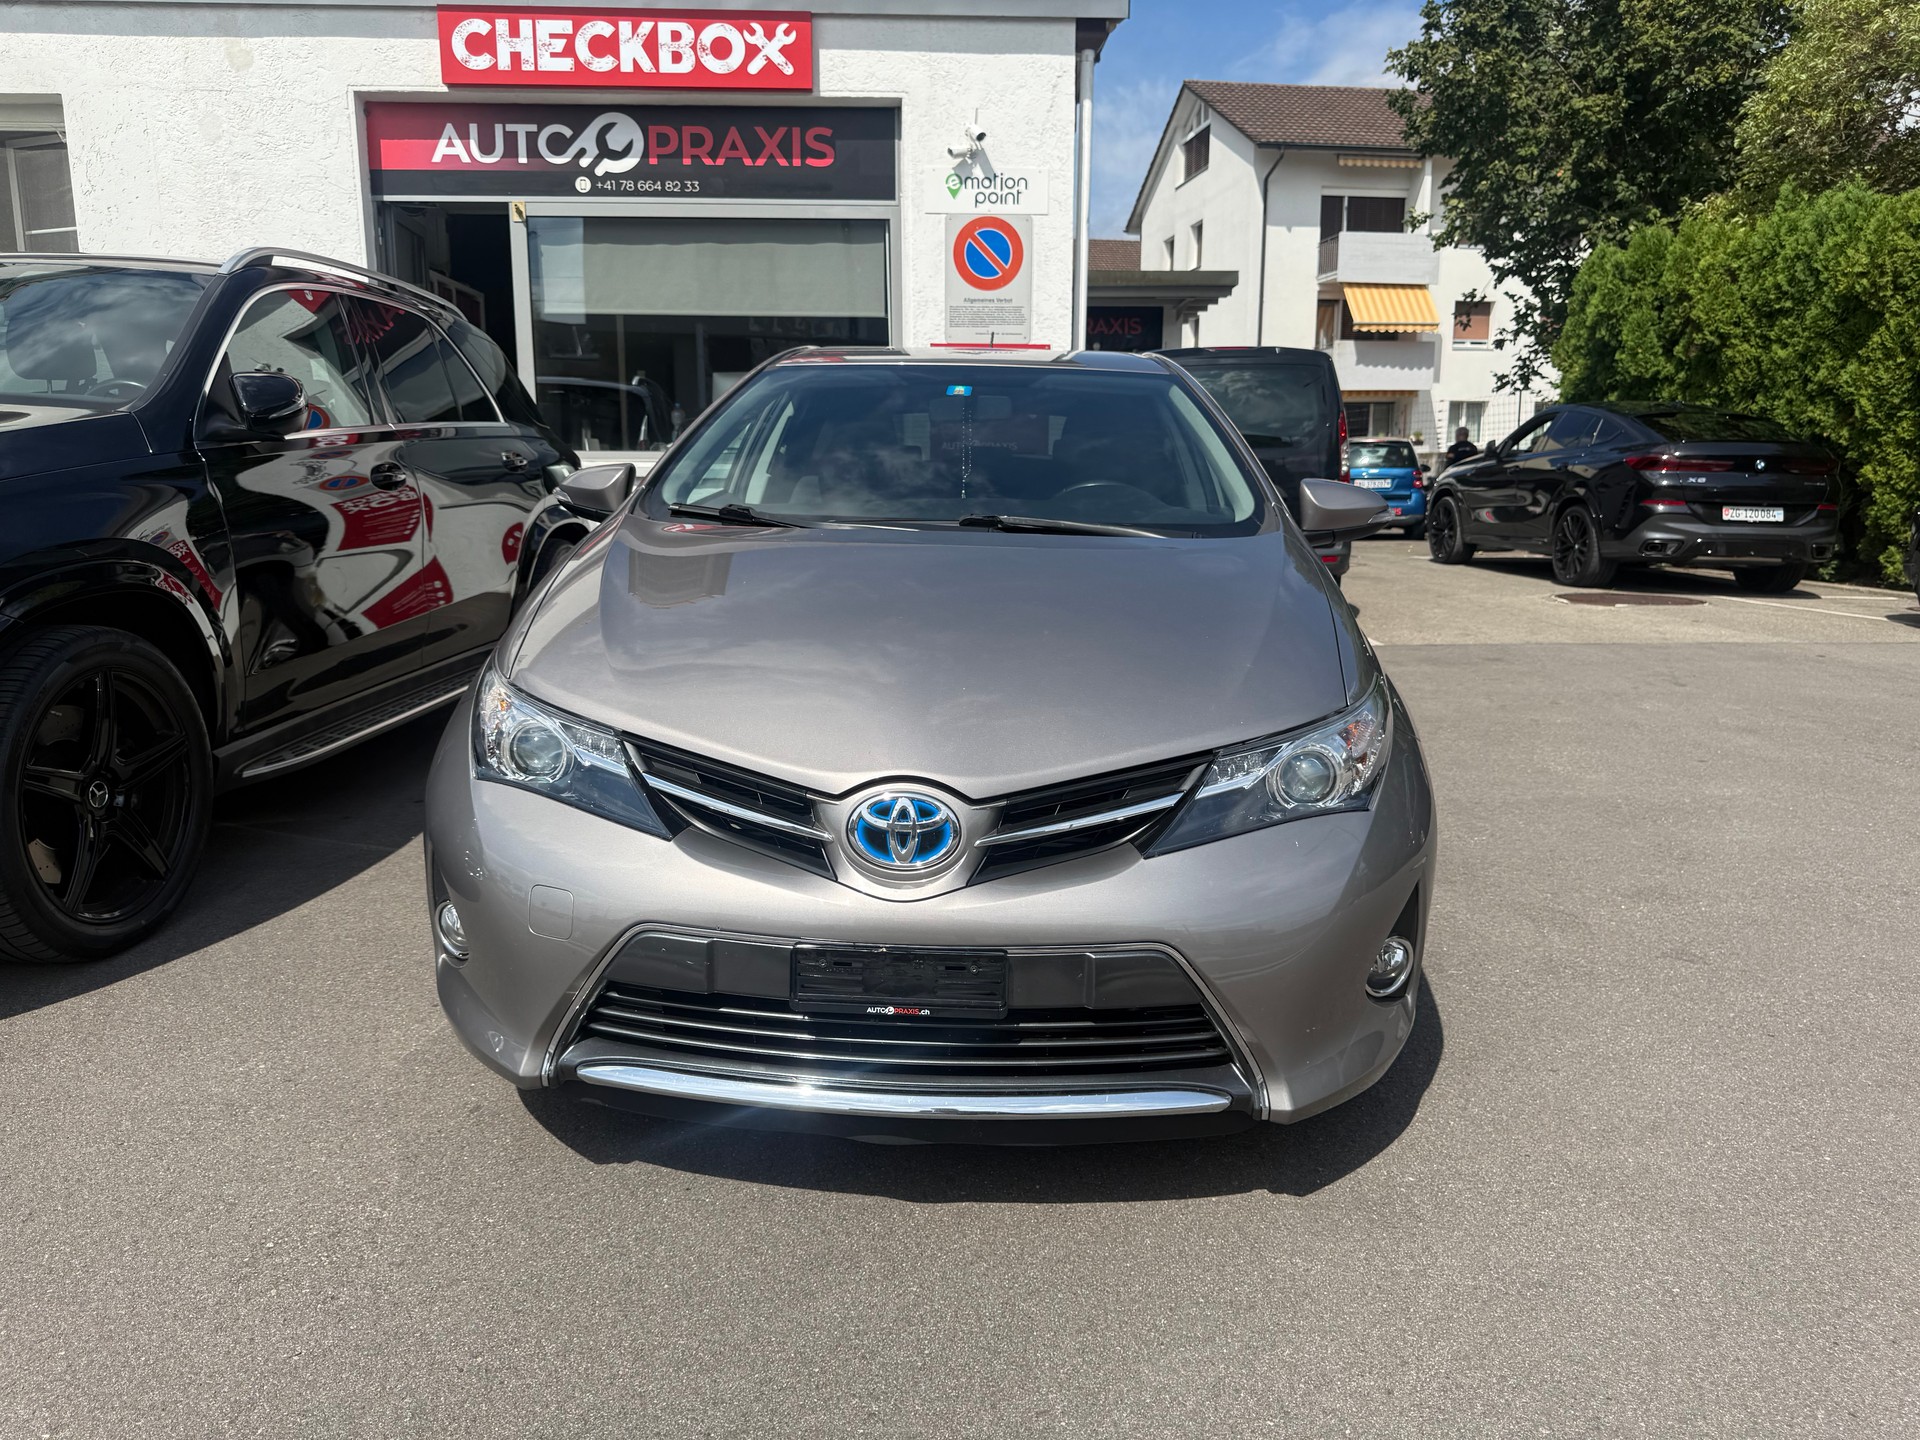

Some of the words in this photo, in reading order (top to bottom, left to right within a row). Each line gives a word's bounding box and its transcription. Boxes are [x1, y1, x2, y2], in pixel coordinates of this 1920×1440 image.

[450, 18, 798, 76] CHECKBOX
[648, 124, 836, 168] PRAXIS
[595, 180, 616, 192] +41
[619, 180, 635, 192] 78
[637, 180, 662, 192] 664
[665, 180, 682, 192] 82
[684, 180, 701, 193] 33
[974, 189, 1022, 208] point
